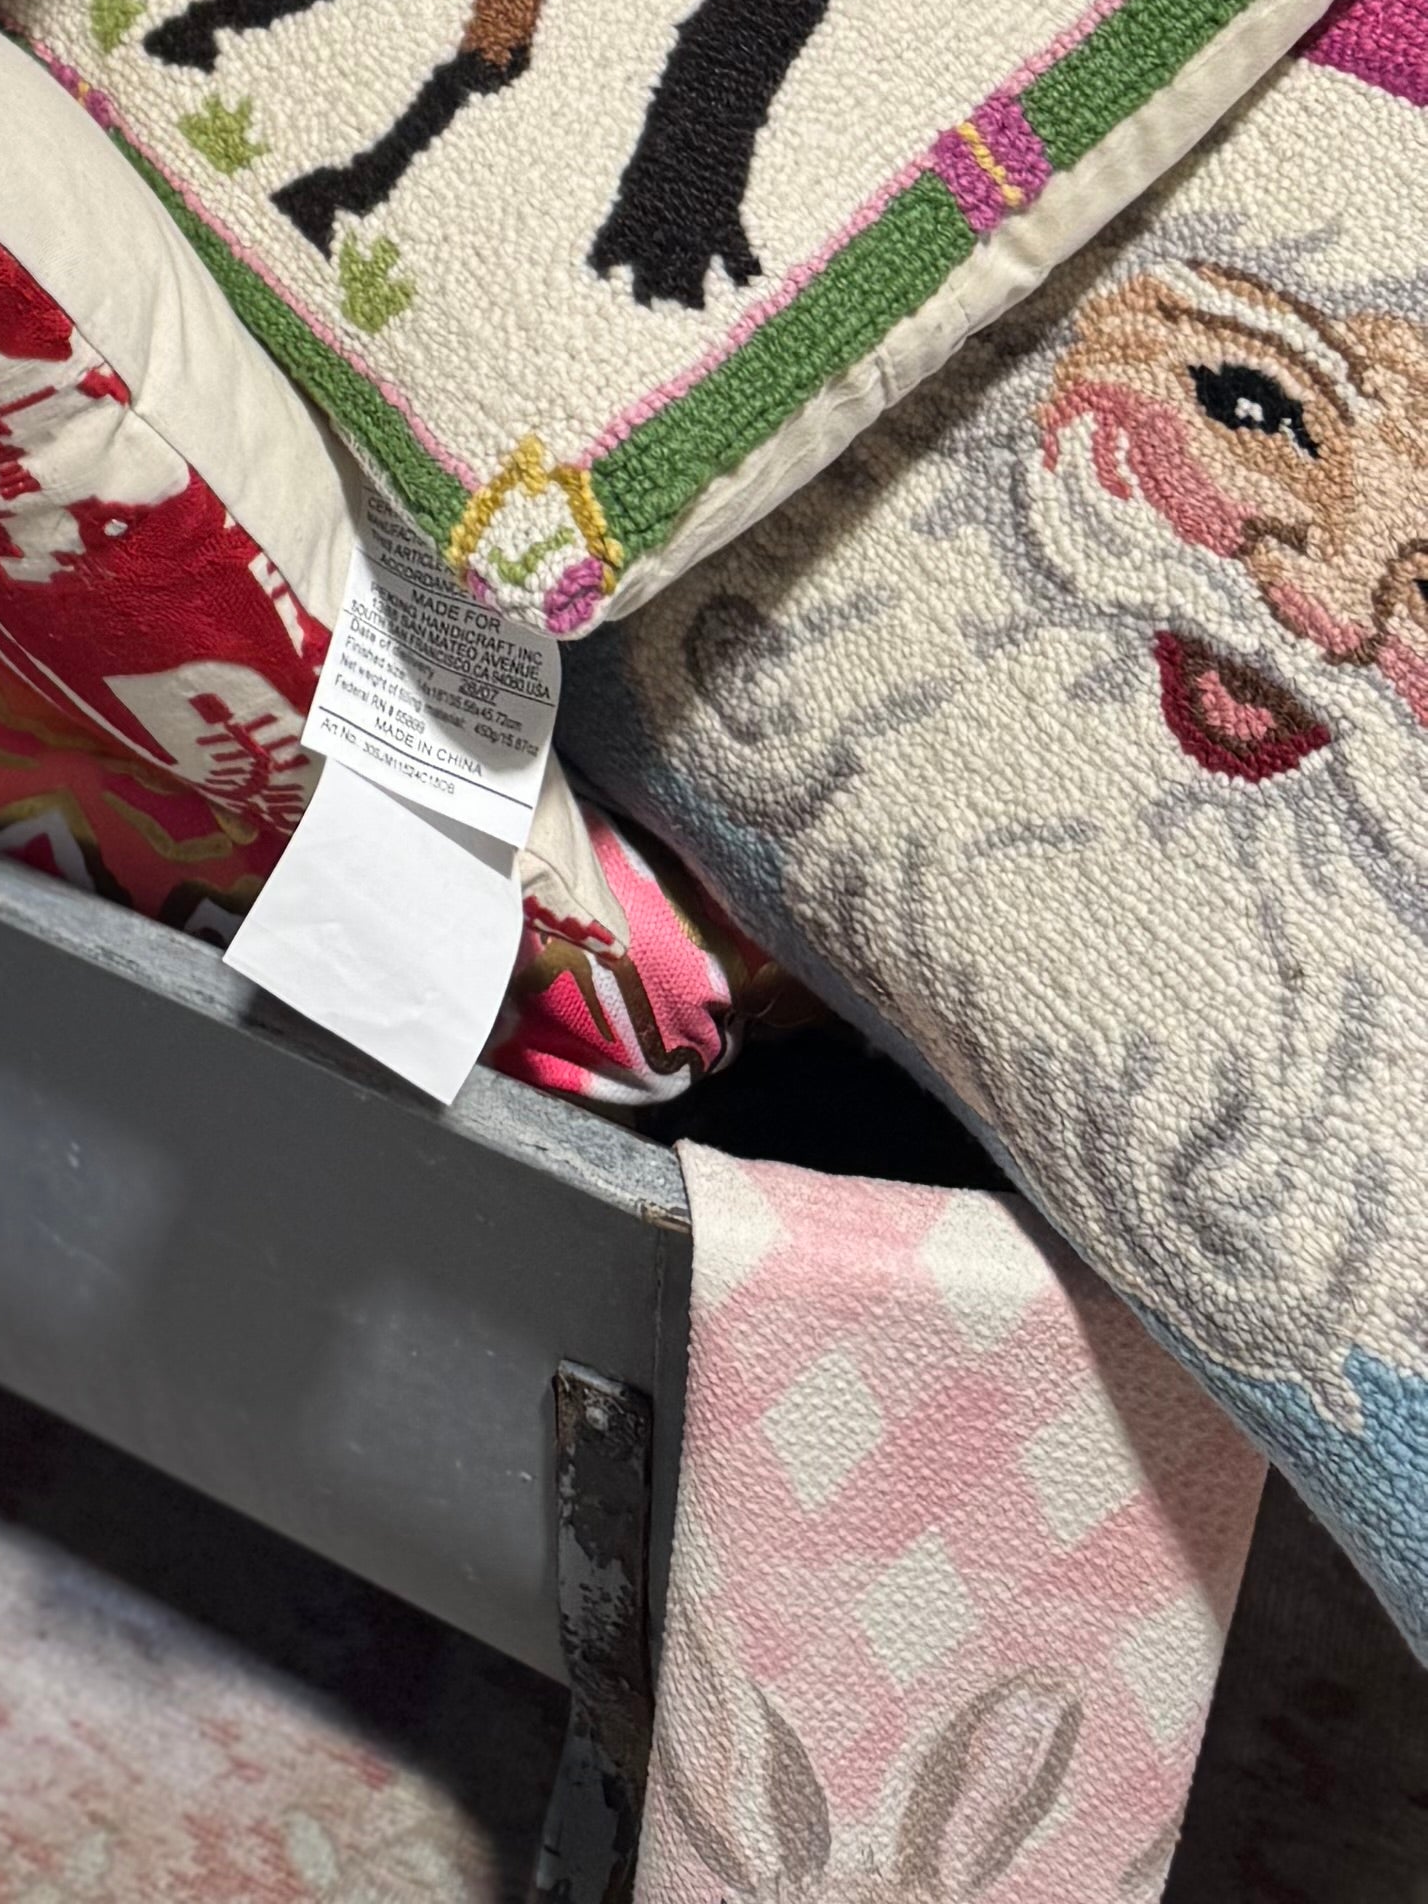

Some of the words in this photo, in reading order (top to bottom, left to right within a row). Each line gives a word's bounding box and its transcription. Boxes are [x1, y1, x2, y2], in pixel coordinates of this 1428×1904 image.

[350, 617, 376, 643] Date
[412, 589, 460, 622] MADE
[465, 606, 502, 634] FOR
[401, 612, 427, 636] SAN
[428, 626, 478, 661] MATEO
[420, 612, 514, 656] HANDICRAFT
[334, 673, 370, 703] Federal
[374, 715, 415, 750] MADE
[417, 734, 433, 757] IN
[435, 747, 483, 778] CHINA
